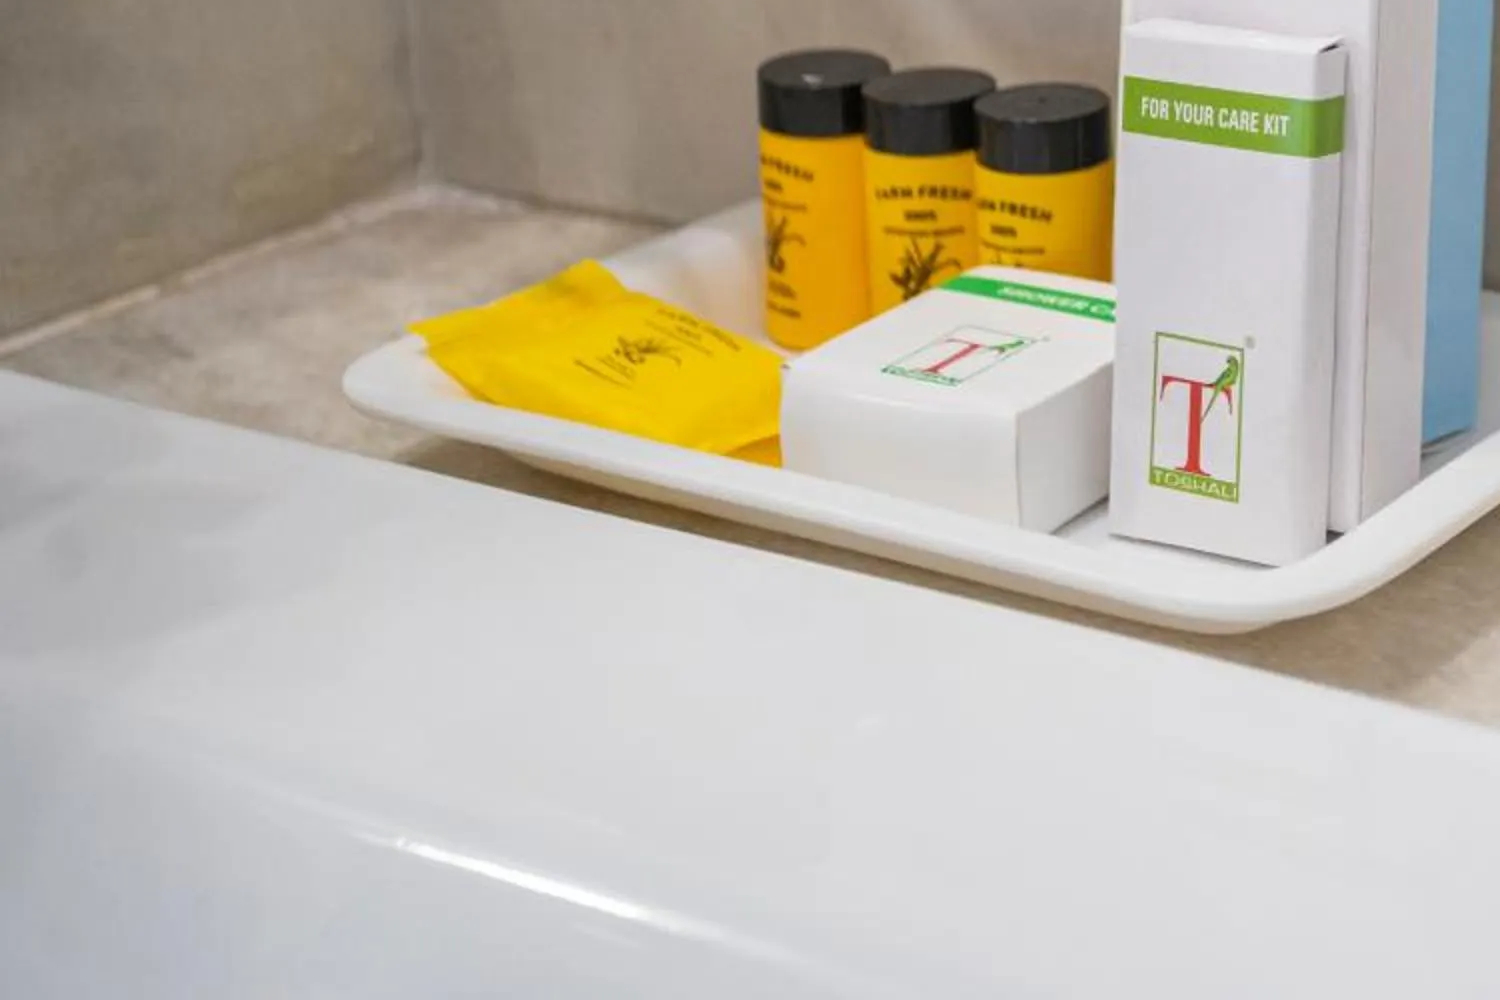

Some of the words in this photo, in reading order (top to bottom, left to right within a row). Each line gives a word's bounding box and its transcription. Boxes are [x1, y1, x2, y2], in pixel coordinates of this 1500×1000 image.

[1141, 96, 1169, 120] FOR
[1174, 101, 1214, 127] YOUR
[1219, 108, 1259, 133] CARE
[1263, 114, 1291, 137] KIT
[1159, 374, 1234, 477] T
[1151, 469, 1238, 501] TOSHALI
